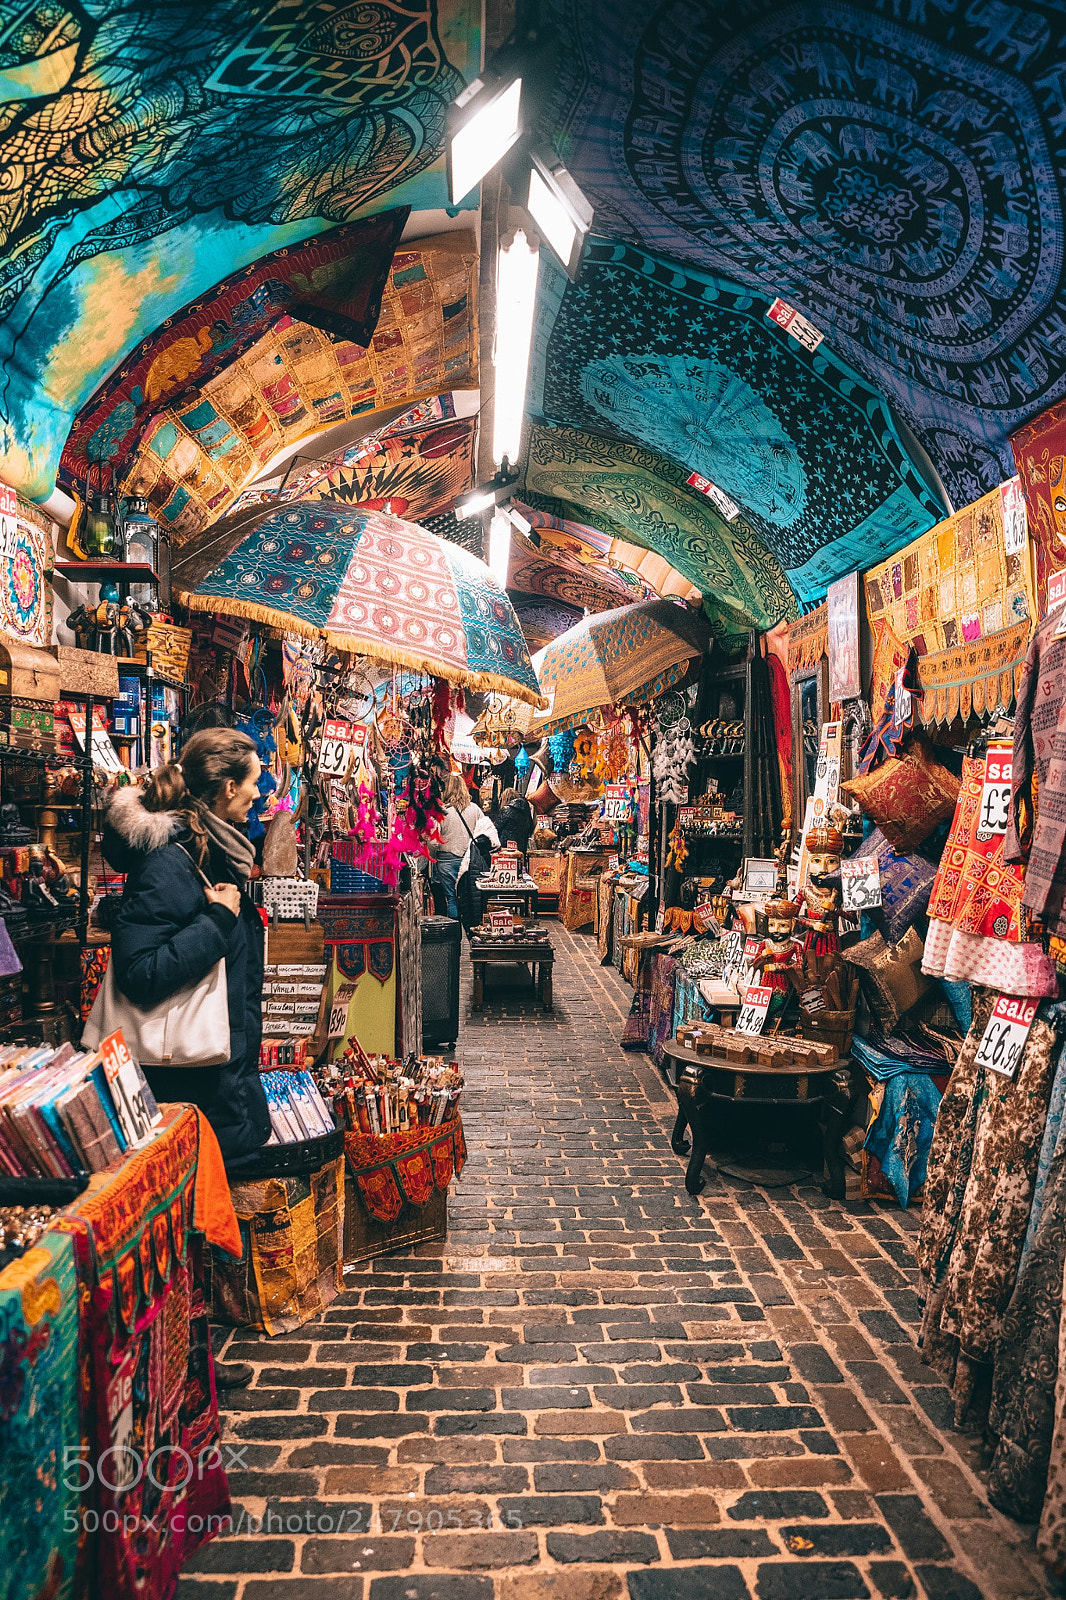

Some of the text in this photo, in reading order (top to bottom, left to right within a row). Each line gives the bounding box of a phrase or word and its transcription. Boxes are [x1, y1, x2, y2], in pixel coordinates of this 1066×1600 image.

[0, 493, 16, 514] ale
[1050, 575, 1066, 602] sal
[72, 716, 102, 729] SAE
[326, 724, 364, 741] sae
[320, 742, 360, 775] £9.9
[499, 872, 515, 884] 69p
[494, 918, 513, 926] sale
[746, 944, 759, 955] sal
[746, 991, 769, 1005] sale
[330, 1007, 346, 1033] 89p
[737, 1007, 764, 1033] £4.99
[997, 998, 1034, 1023] sale
[105, 1039, 128, 1077] sale
[978, 1022, 1021, 1072] £6.99
